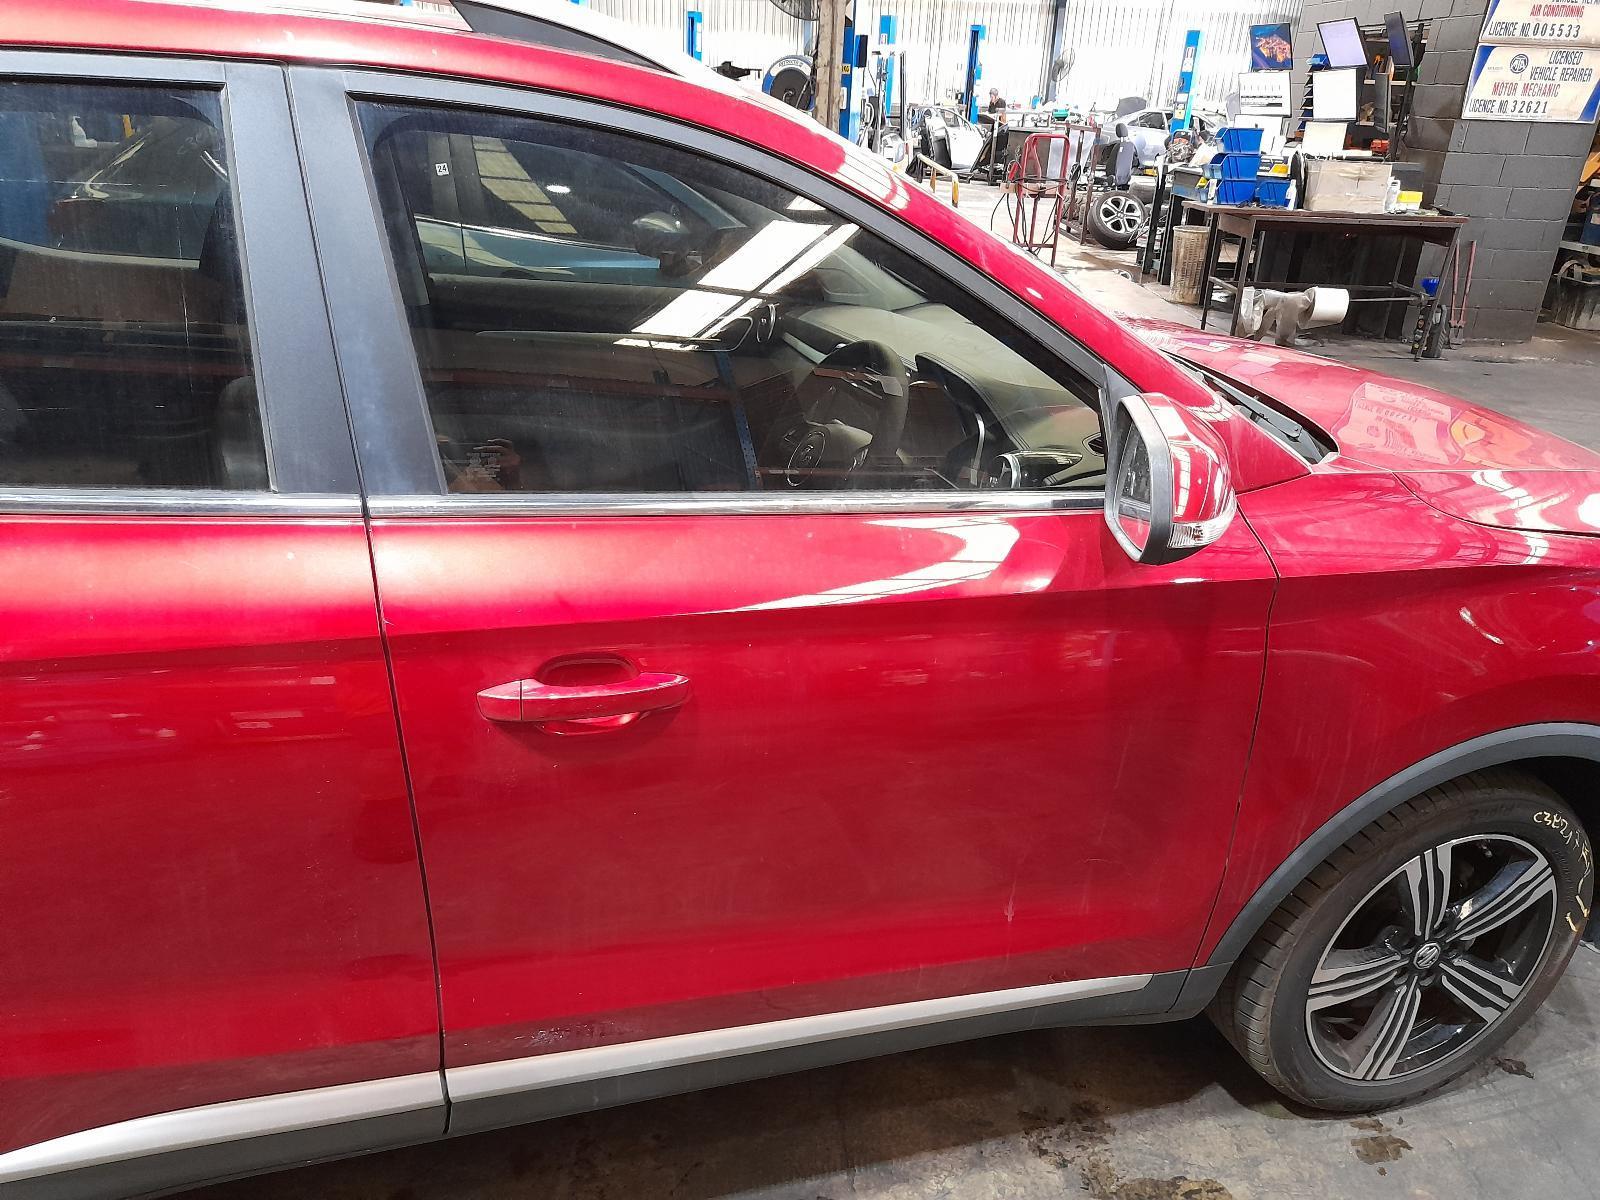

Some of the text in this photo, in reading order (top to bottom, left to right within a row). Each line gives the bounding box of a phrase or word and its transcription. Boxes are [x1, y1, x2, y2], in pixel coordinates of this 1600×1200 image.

[1530, 5, 1585, 18] AIR CONDITIONING
[1488, 21, 1518, 36] LICENCE
[1532, 22, 1581, 38] 005533
[1548, 50, 1584, 65] LICENSED
[1529, 66, 1593, 82] VEHICLE REPAIRER
[1491, 81, 1561, 98] MOTOR MECHANIC
[1468, 98, 1497, 114] LICENCE
[1510, 100, 1548, 114] 32621
